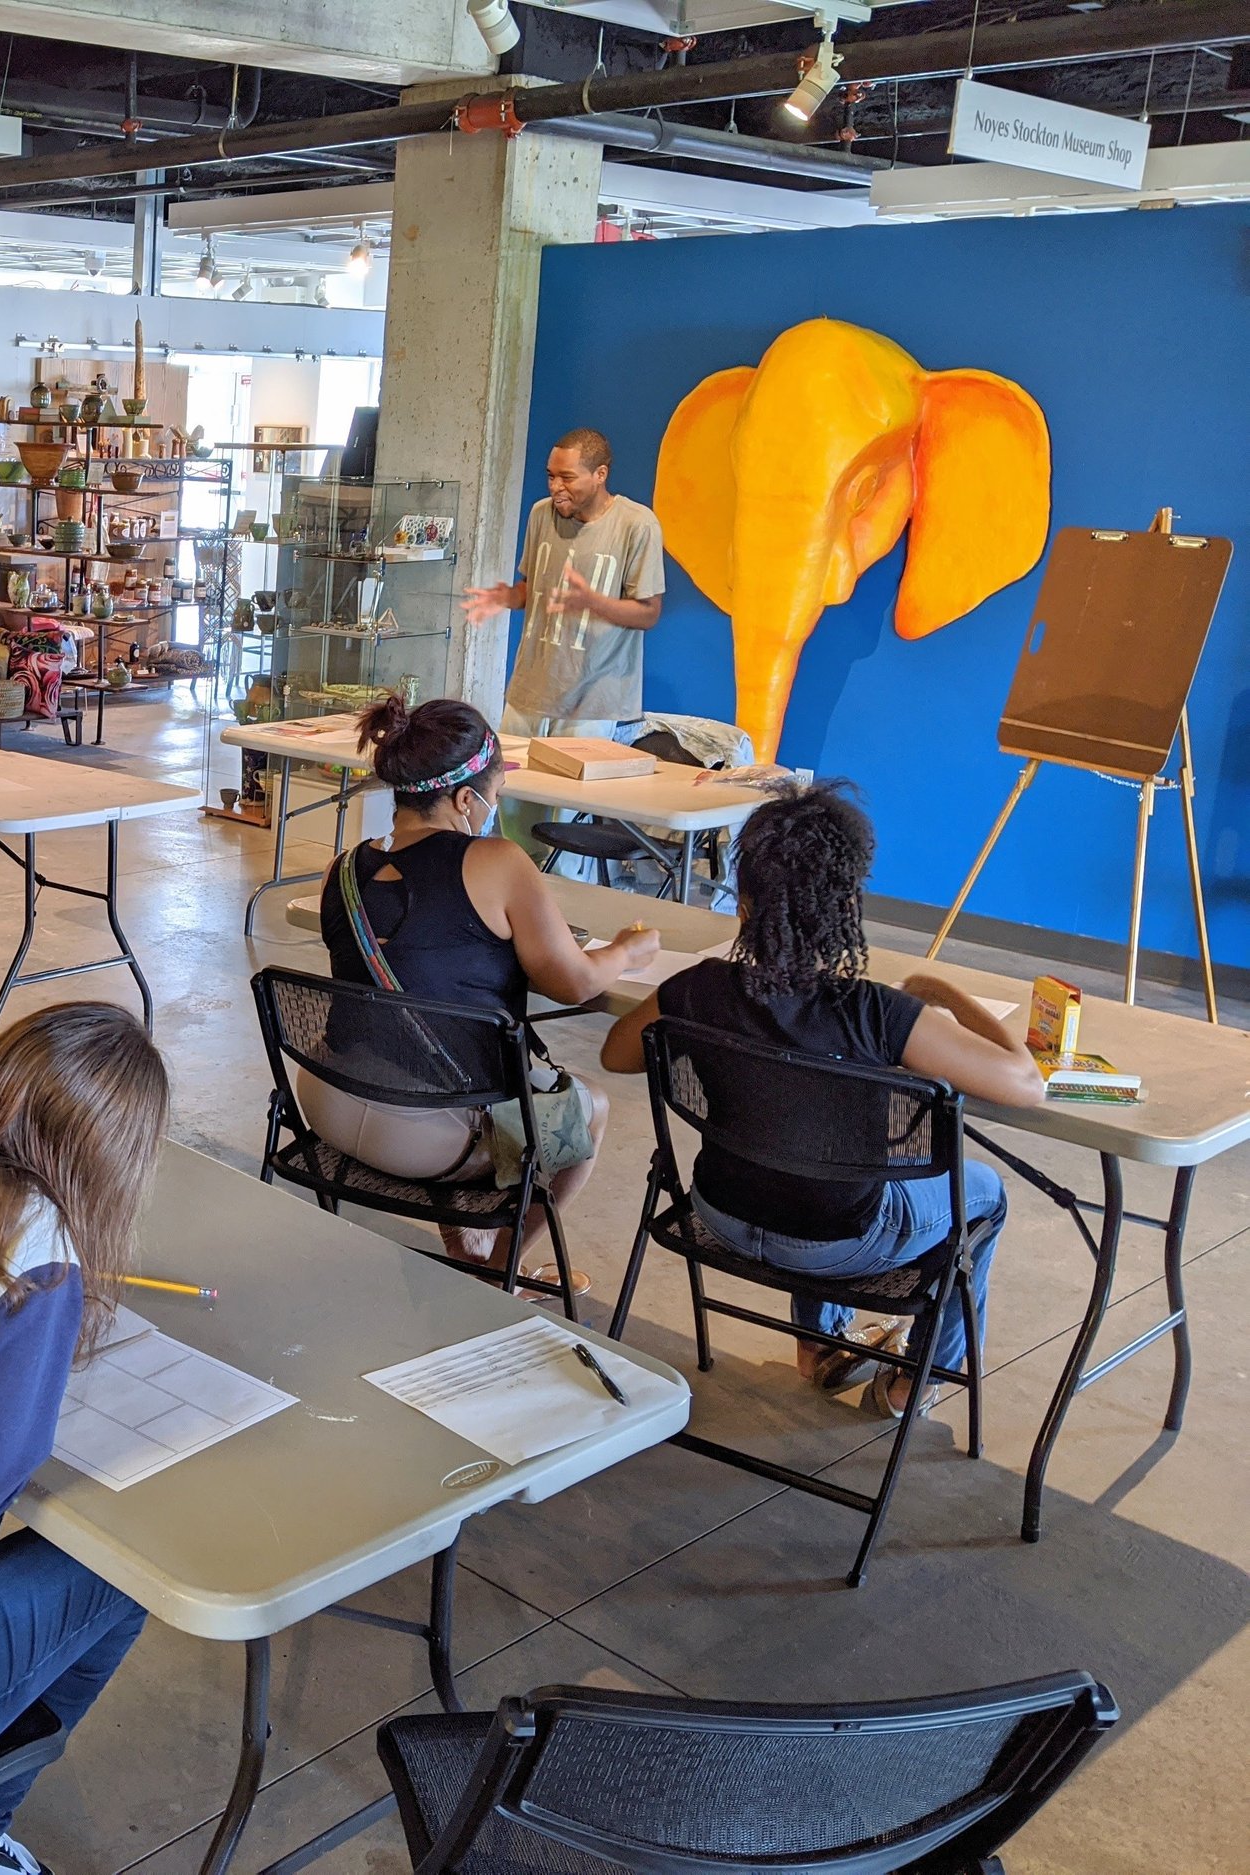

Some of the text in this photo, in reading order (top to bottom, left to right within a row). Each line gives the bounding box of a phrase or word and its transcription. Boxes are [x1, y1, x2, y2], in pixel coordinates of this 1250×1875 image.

[974, 109, 1132, 170] Noyes Stockton Museum Shop
